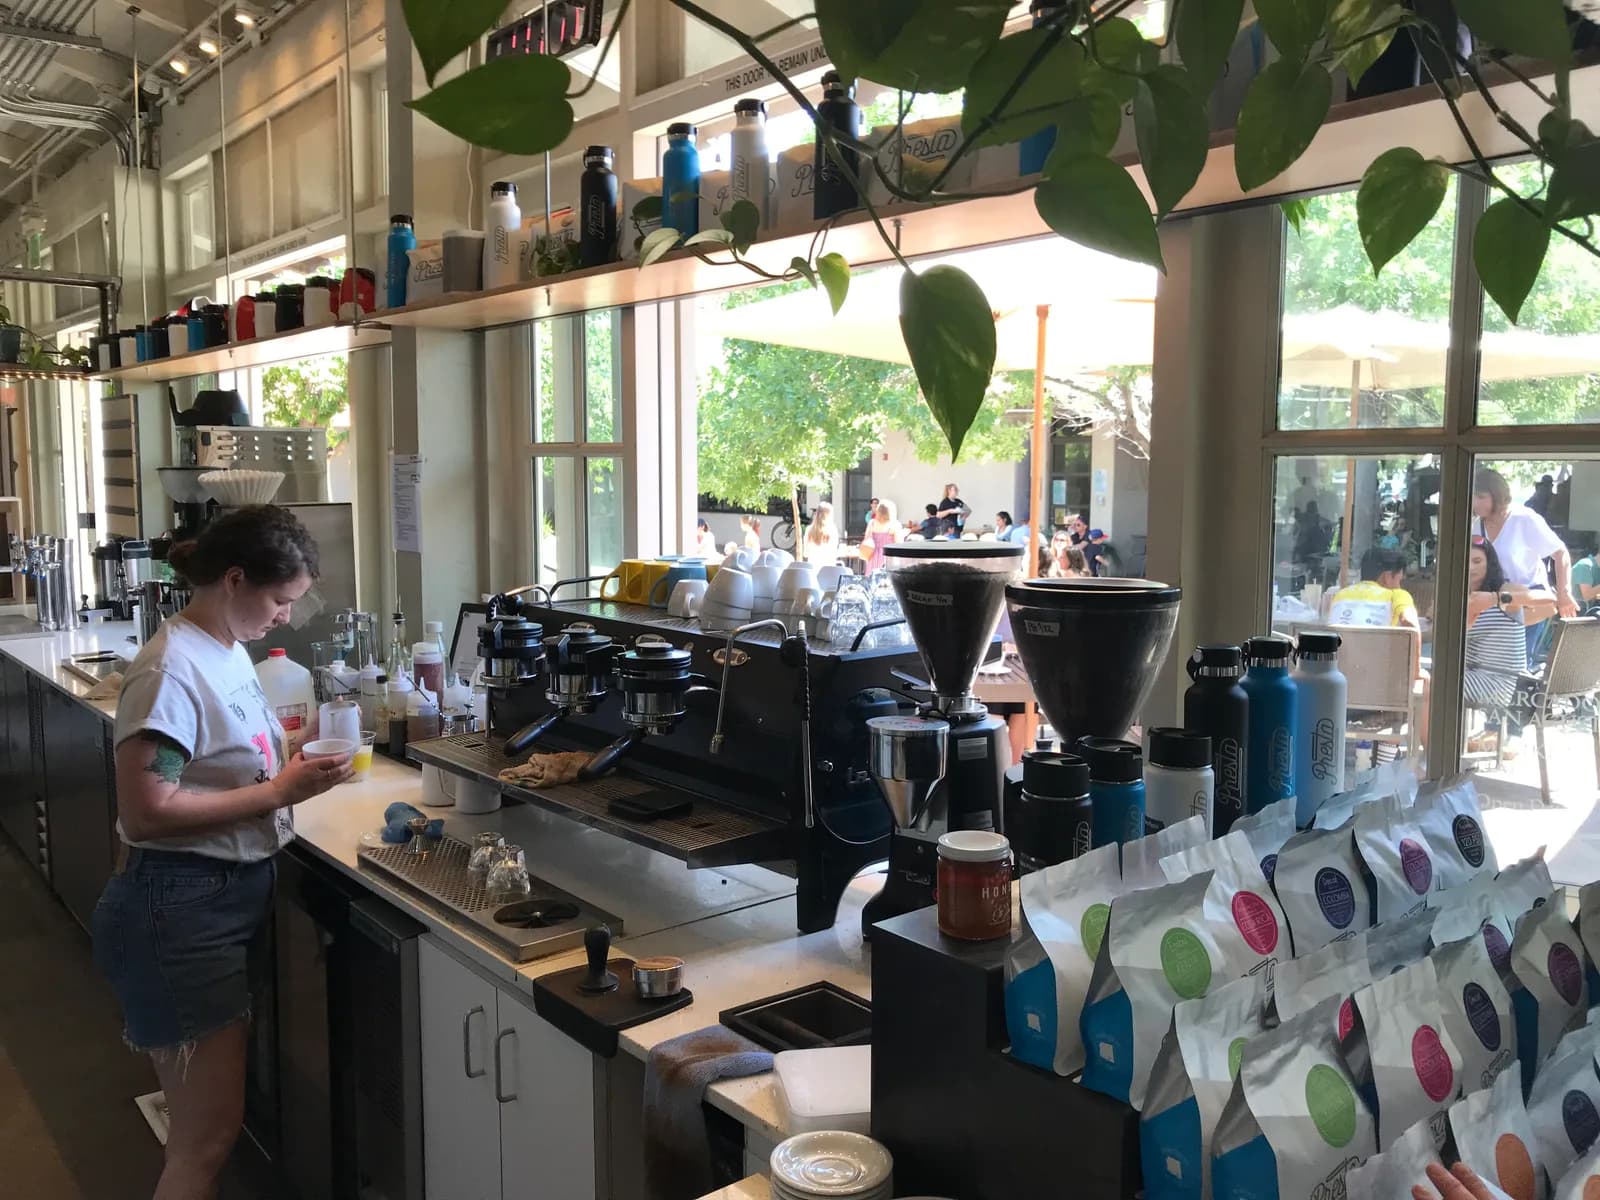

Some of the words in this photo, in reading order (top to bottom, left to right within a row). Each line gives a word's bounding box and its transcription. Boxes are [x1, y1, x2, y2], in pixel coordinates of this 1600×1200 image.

[725, 76, 741, 91] THIS
[743, 67, 764, 86] DOOR
[882, 128, 957, 174] Presta
[1215, 737, 1243, 809] Presta
[1312, 718, 1340, 785] Presta
